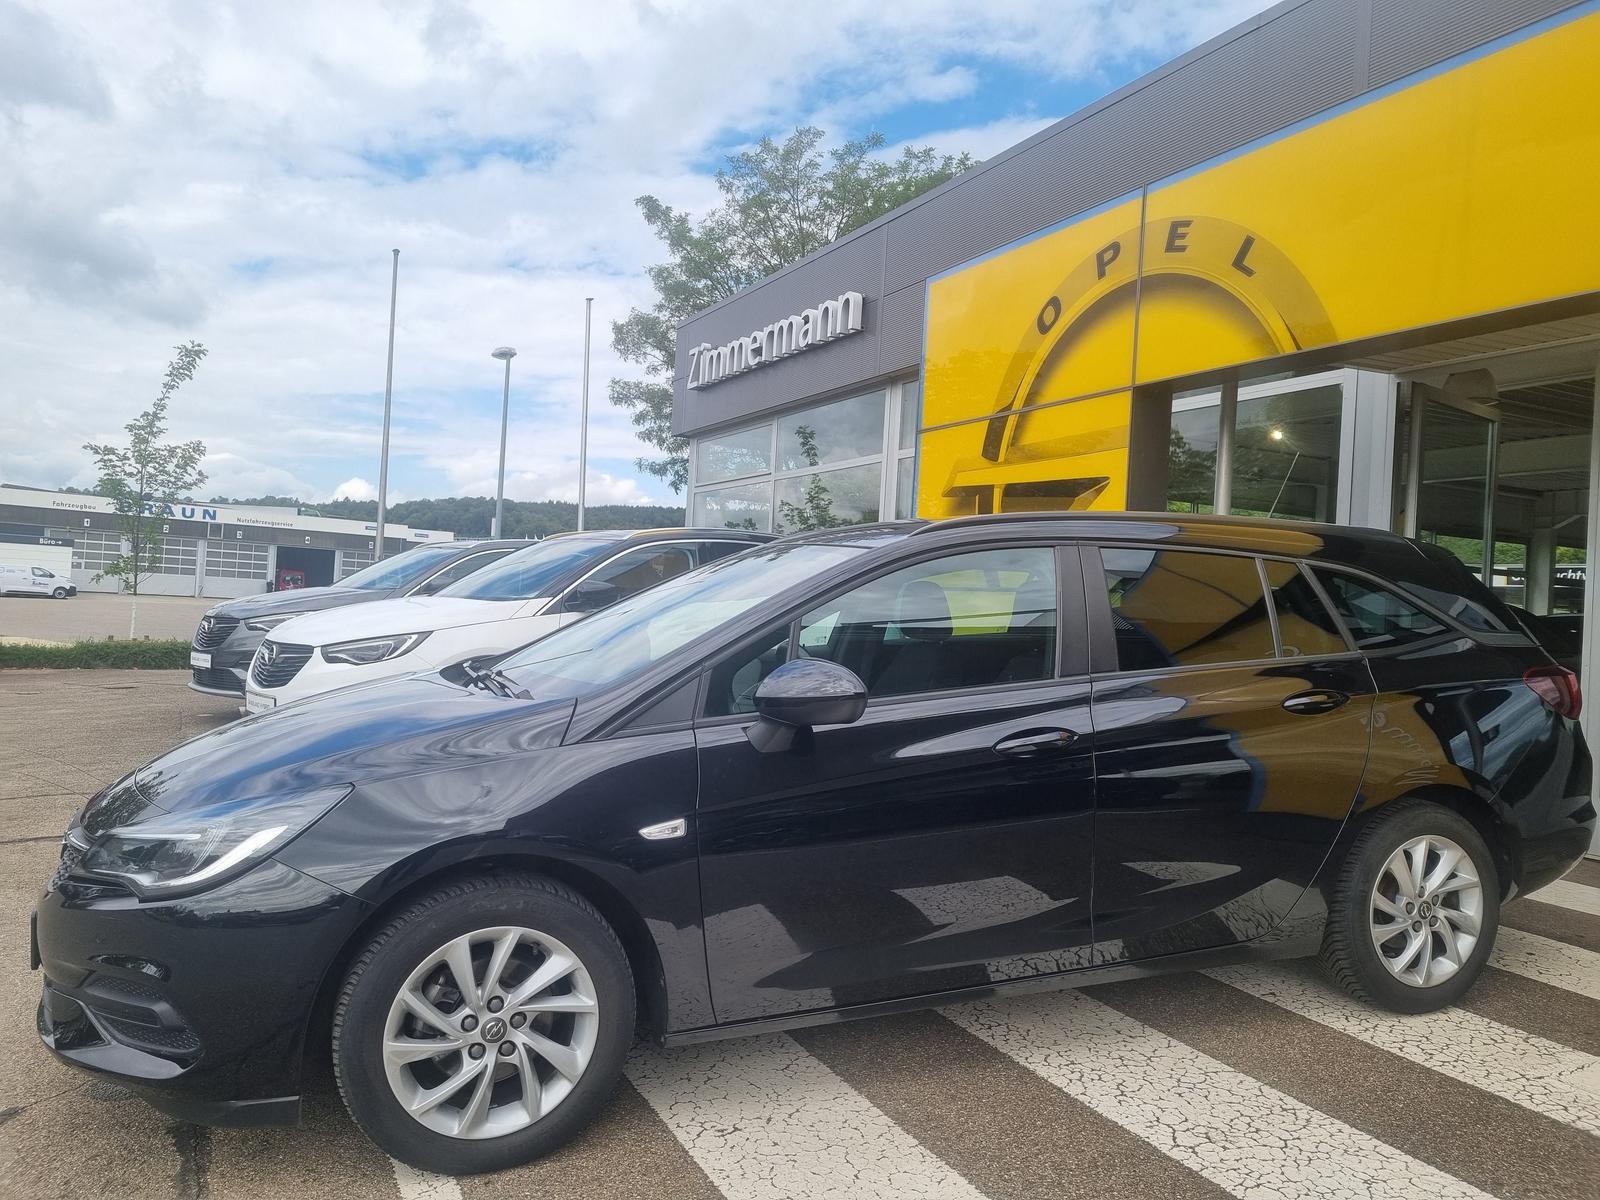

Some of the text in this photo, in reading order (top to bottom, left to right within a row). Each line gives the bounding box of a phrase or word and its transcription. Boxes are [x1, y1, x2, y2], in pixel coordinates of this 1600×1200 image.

[1036, 219, 1257, 336] OPEL
[687, 291, 864, 391] Zimmermann
[52, 500, 97, 510] Fahrzeugbau
[236, 517, 294, 528] Nutzfahrzeugservice
